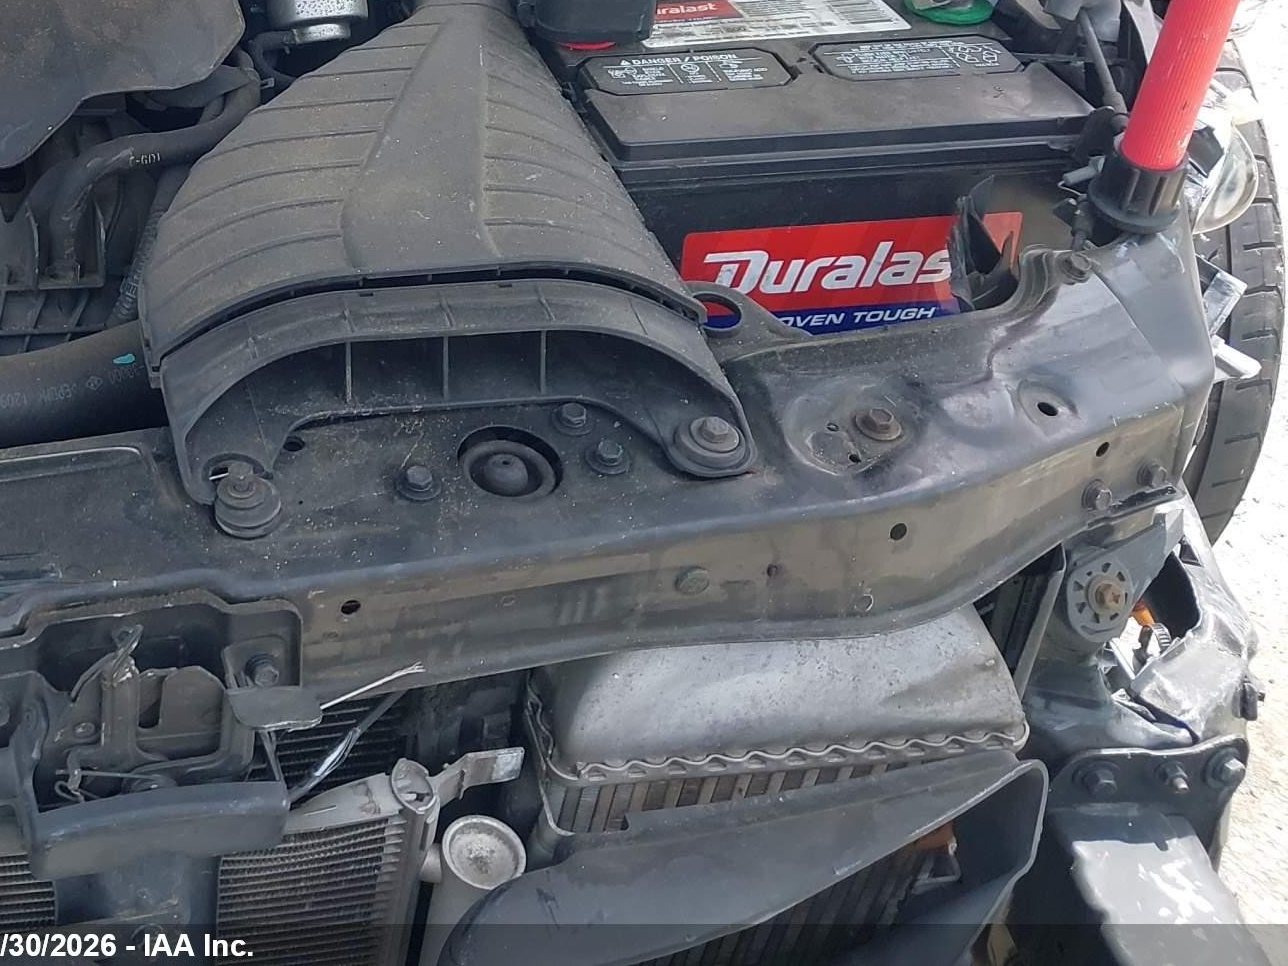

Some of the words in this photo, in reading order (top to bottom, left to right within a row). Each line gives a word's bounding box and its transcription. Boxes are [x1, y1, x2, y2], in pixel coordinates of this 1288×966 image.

[655, 2, 717, 15] ralast
[631, 56, 682, 65] DANGER
[692, 53, 737, 62] POISON
[703, 241, 952, 296] Duralas
[779, 312, 845, 327] OVEN
[853, 307, 936, 323] TOUGH
